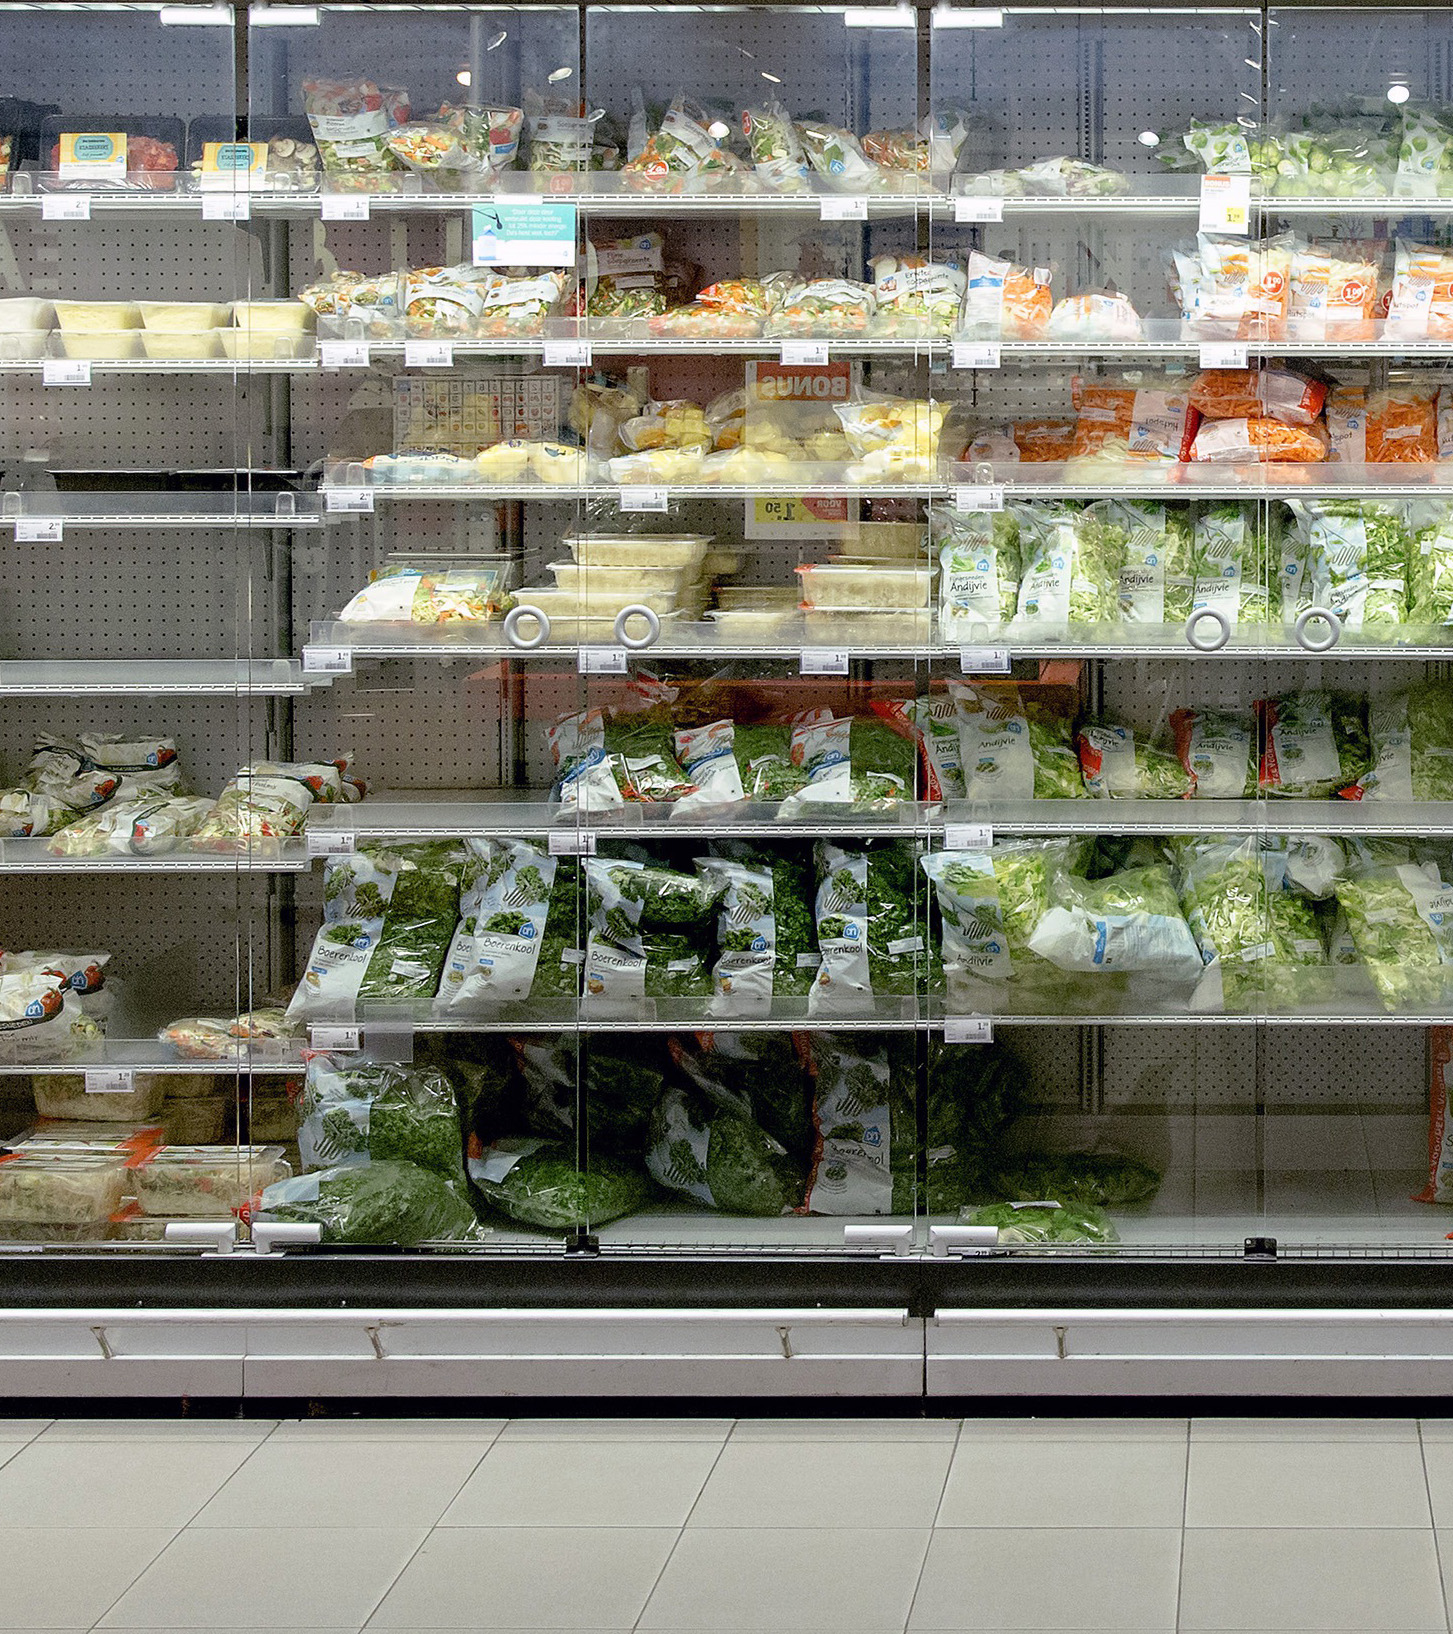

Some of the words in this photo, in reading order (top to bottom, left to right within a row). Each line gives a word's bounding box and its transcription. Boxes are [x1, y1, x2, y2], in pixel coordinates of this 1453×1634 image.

[1030, 579, 1060, 591] Andijvie
[1118, 574, 1154, 587] Andijvie
[950, 580, 988, 595] Andijvie
[1195, 582, 1230, 596] Andijvie
[1279, 726, 1318, 737] Andijvie
[935, 743, 960, 755] Andij
[978, 736, 1016, 749] Andijvie
[483, 937, 535, 955] Boerenkool
[317, 945, 368, 964] Boerenkool
[591, 950, 643, 967] Boerenkool
